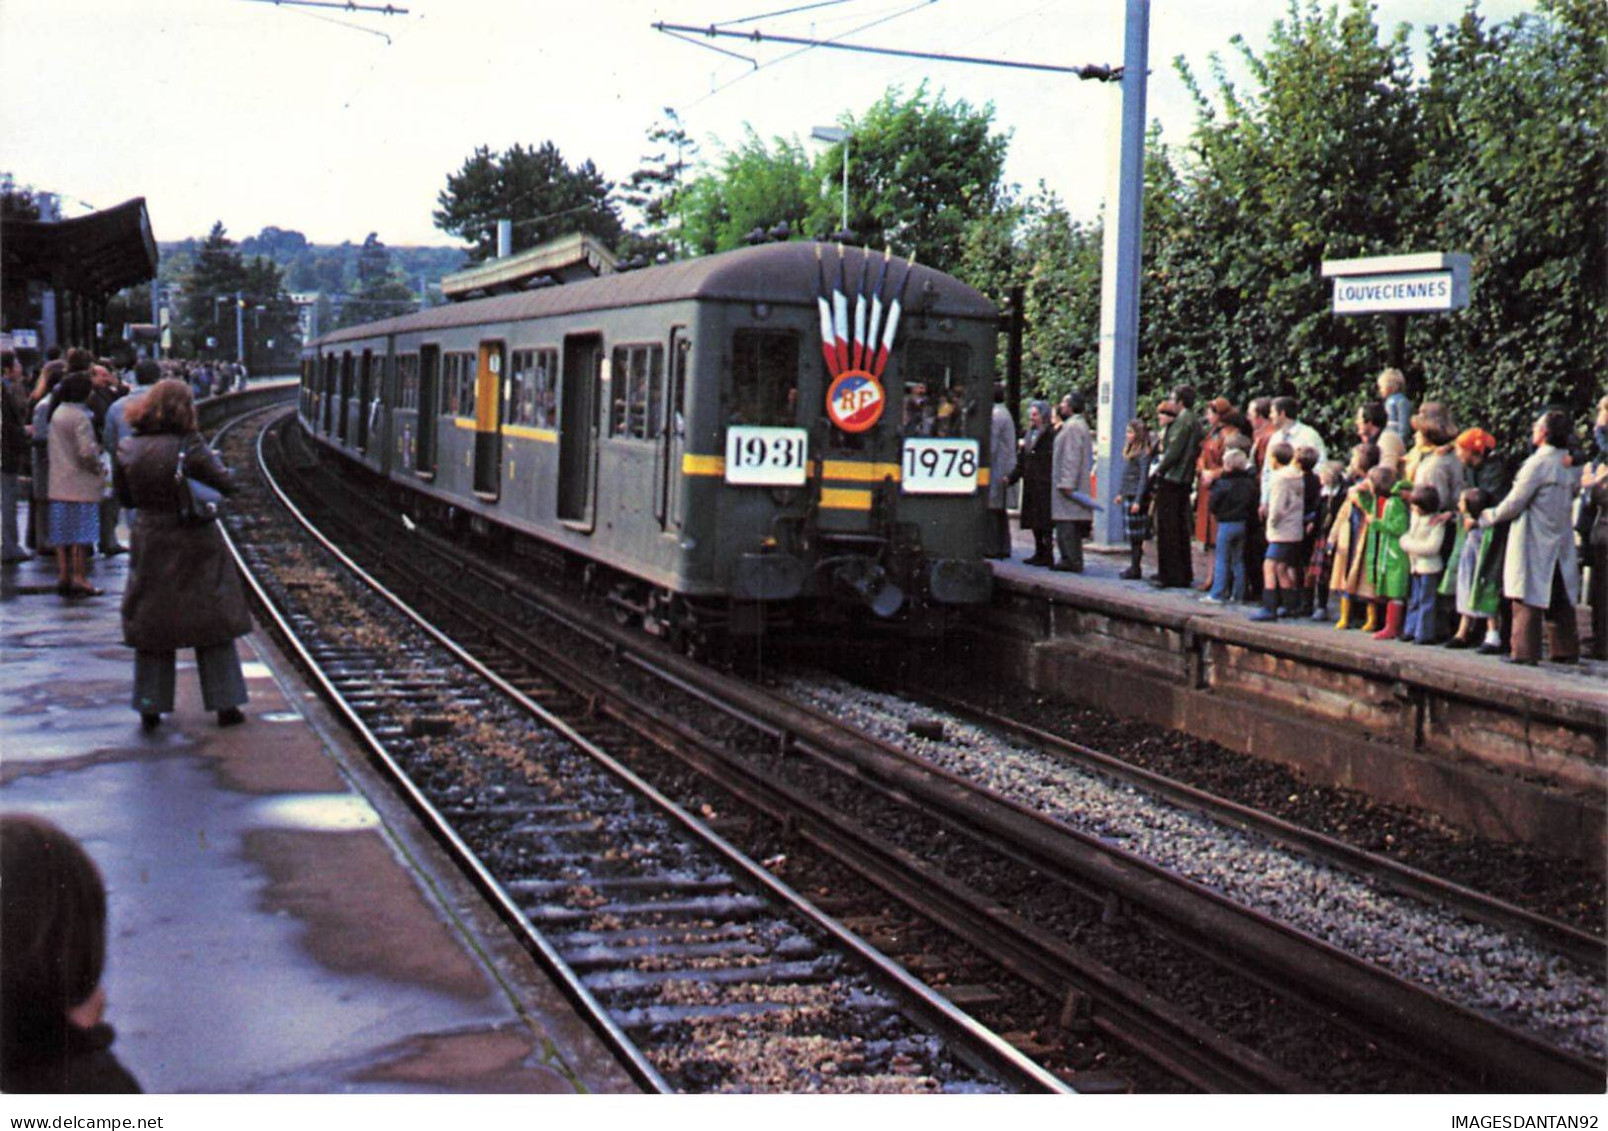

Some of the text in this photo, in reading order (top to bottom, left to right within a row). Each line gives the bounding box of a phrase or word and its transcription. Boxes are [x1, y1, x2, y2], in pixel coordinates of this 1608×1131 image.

[1338, 281, 1447, 301] LOUVECIENNES
[840, 388, 873, 411] RF
[734, 436, 805, 468] 1931
[905, 447, 977, 478] 1978
